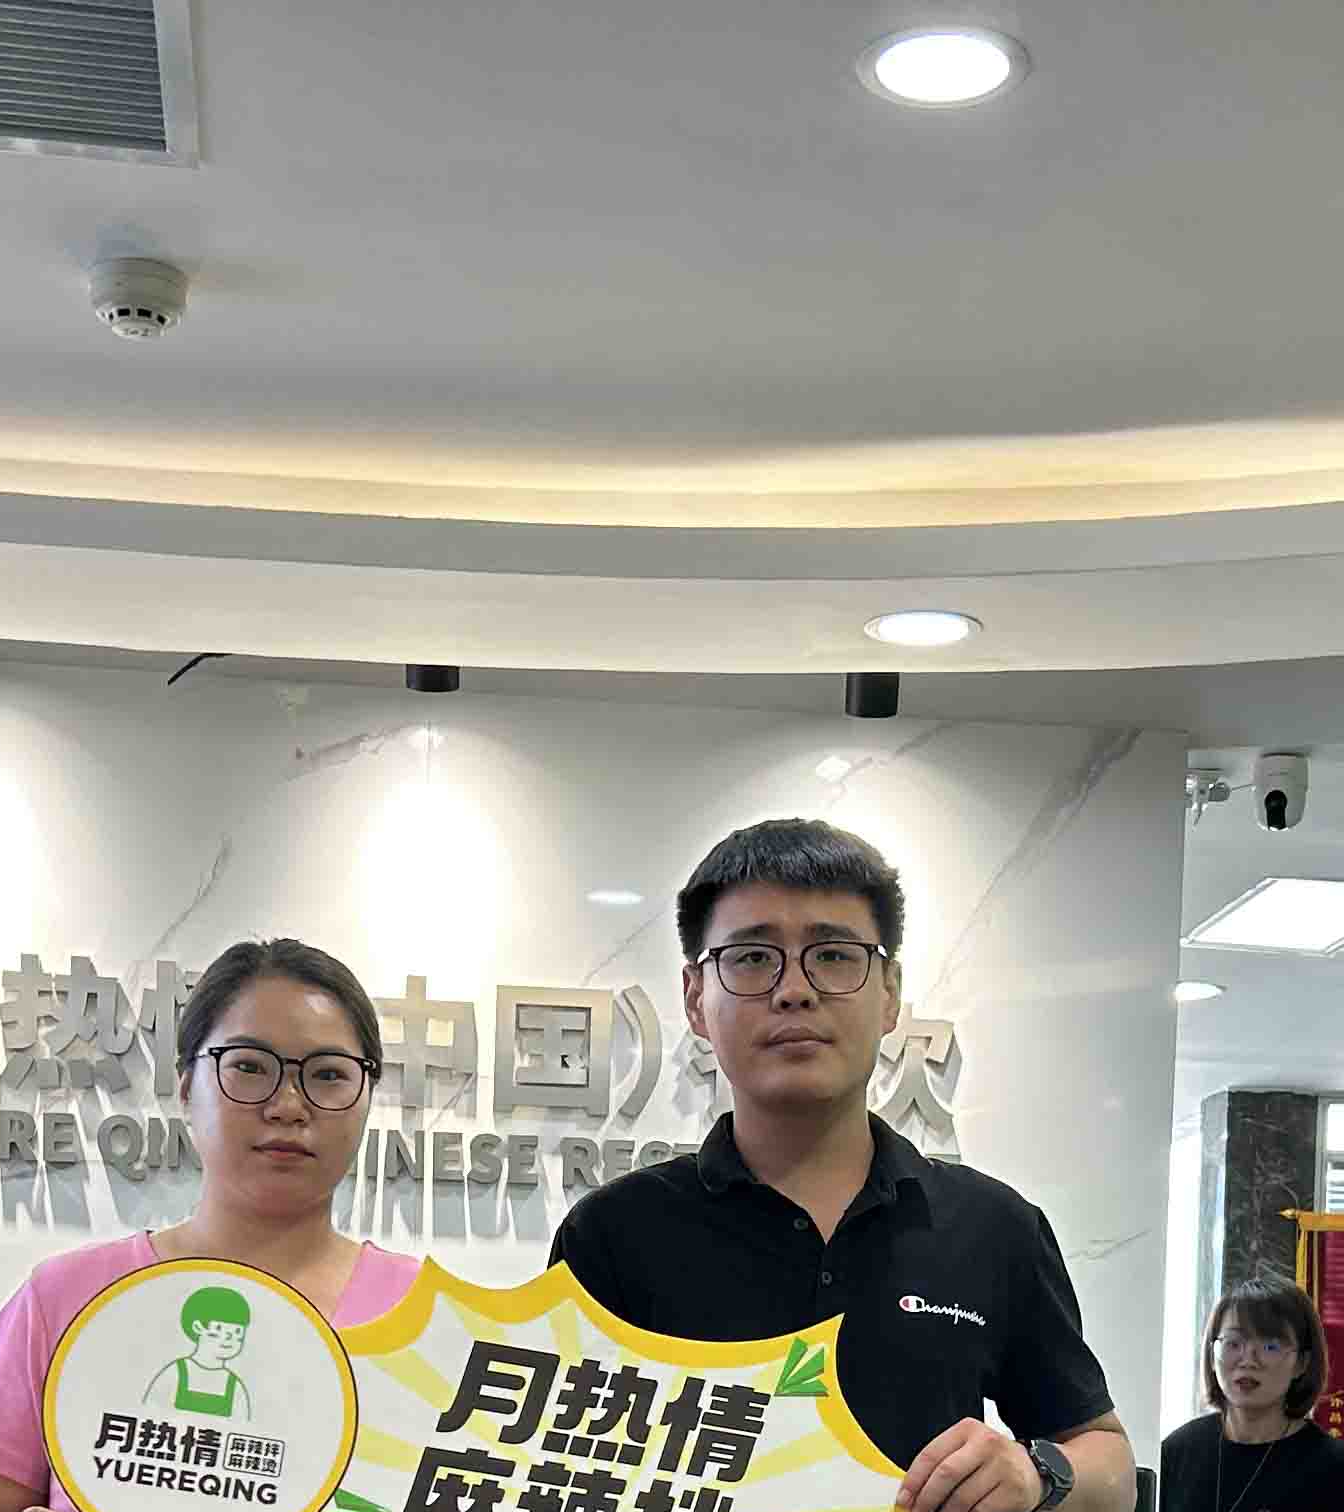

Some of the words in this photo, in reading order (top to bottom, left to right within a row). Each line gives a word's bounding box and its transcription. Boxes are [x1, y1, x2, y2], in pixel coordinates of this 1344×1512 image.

[97, 1114, 204, 1181] QIN
[356, 1128, 539, 1186] INESE
[436, 1340, 772, 1483] 月热情
[94, 1412, 222, 1468] 月热情
[227, 1453, 278, 1475] 麻辣烫
[230, 1437, 281, 1457] 麻辣拌
[93, 1455, 278, 1505] YUEREQING
